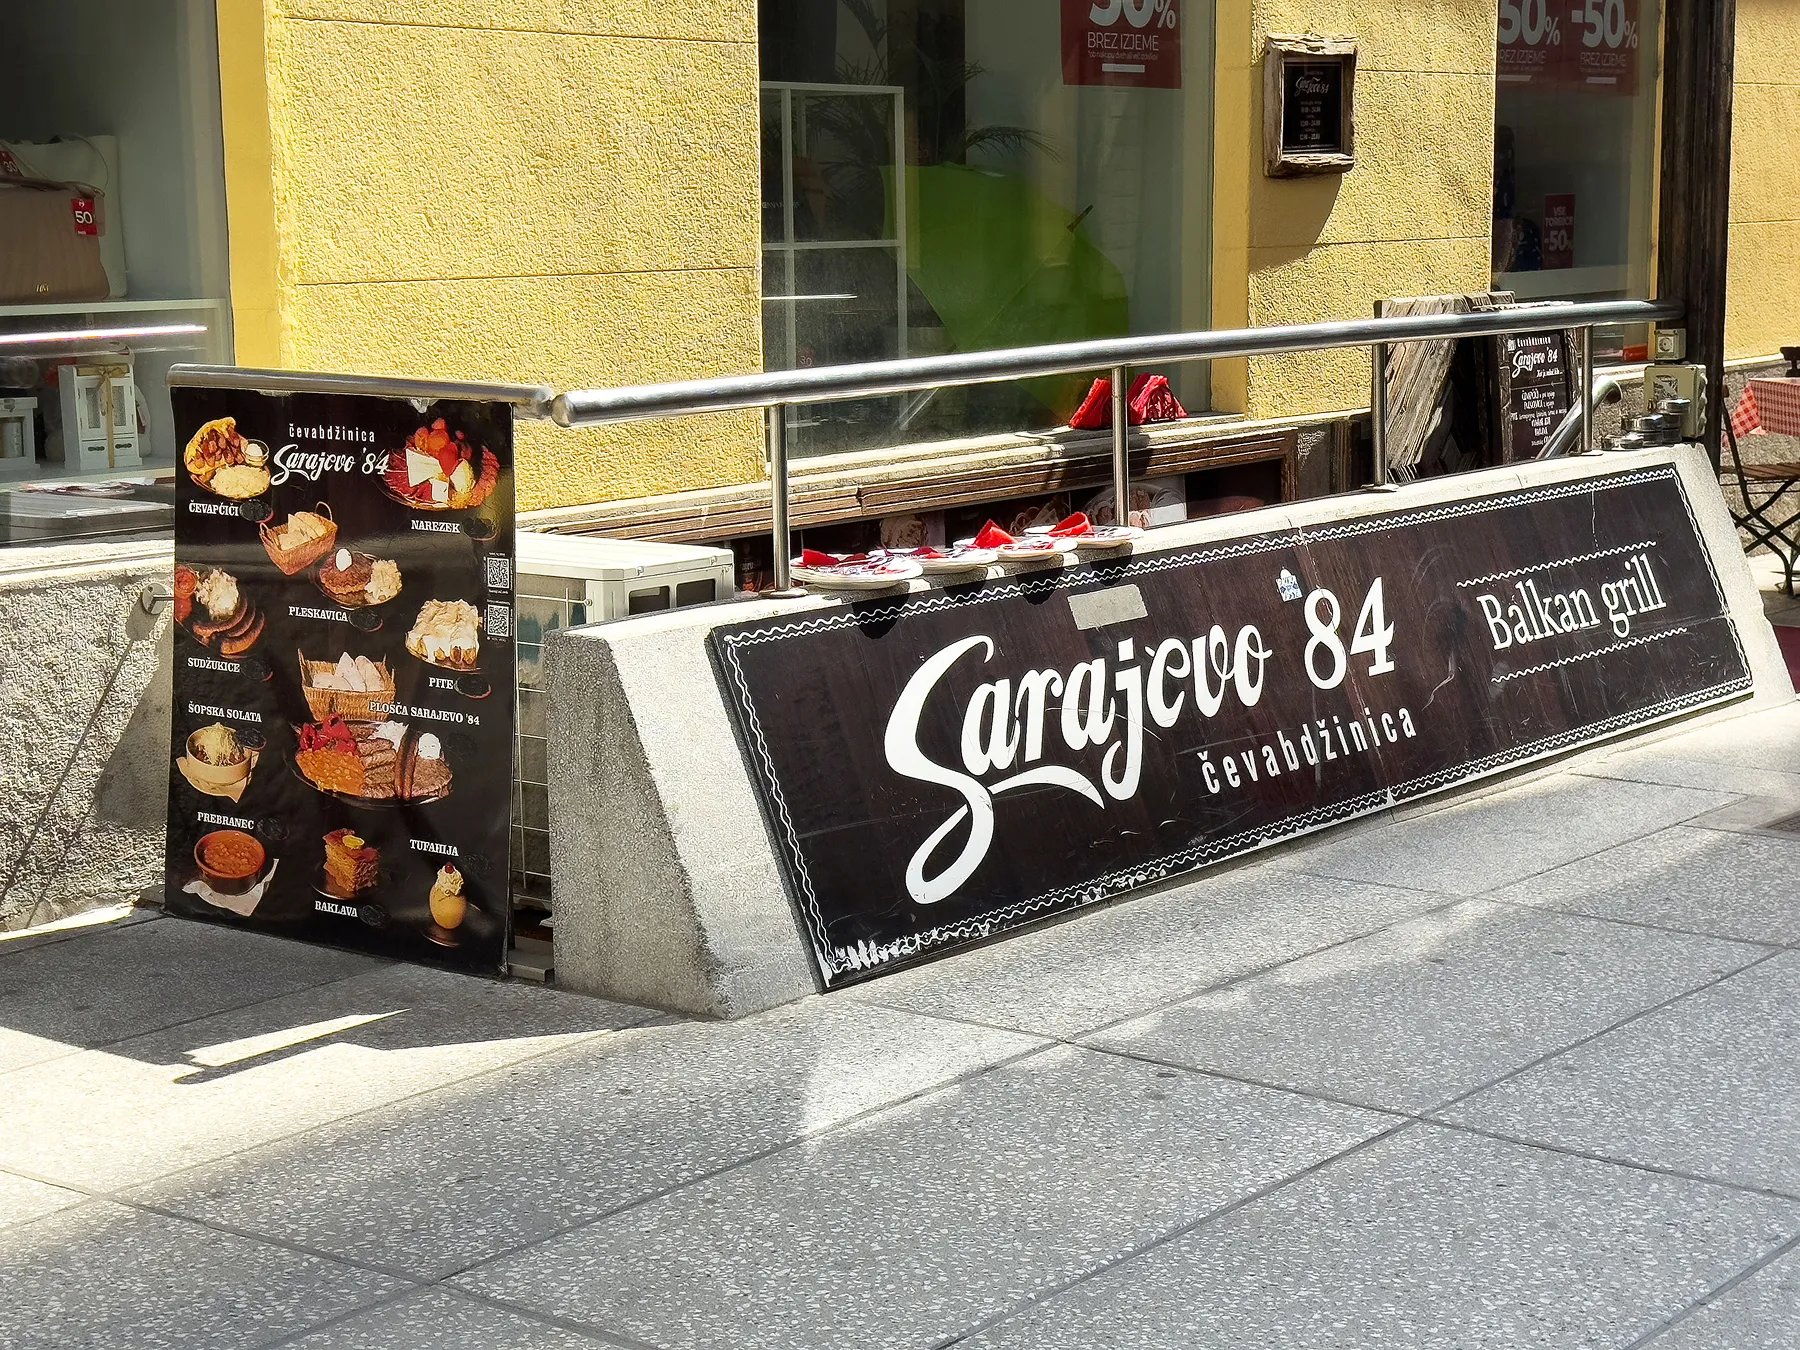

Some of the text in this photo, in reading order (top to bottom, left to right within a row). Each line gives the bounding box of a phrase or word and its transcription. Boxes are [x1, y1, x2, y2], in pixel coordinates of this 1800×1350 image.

[1571, 0, 1638, 49] -50%
[1087, 31, 1159, 51] BREZ IZJEME
[1499, 49, 1547, 64] REZ IZJEME
[1580, 52, 1628, 67] BREZ IZJEME
[74, 210, 94, 225] 50
[1553, 206, 1568, 216] VSE
[288, 422, 376, 443] čevabdžinica
[270, 443, 391, 486] Sarajevo '84
[410, 519, 461, 534] NAREZEK
[1476, 552, 1667, 651] Balkan grill
[288, 606, 349, 623] PLESKAVICA
[187, 655, 241, 673] SUDŽUKICE
[428, 676, 455, 691] PITE
[188, 700, 263, 724] ŠOPSKA SOLATA
[369, 701, 480, 726] PLOŠČA SARAJEVO '84
[884, 575, 1396, 905] Sarajevo 84
[1197, 705, 1418, 796] čevabdžinica
[197, 811, 255, 830] PREBRANEC
[409, 839, 460, 857] TUFAHIJA
[314, 900, 359, 918] BAKLAVA
